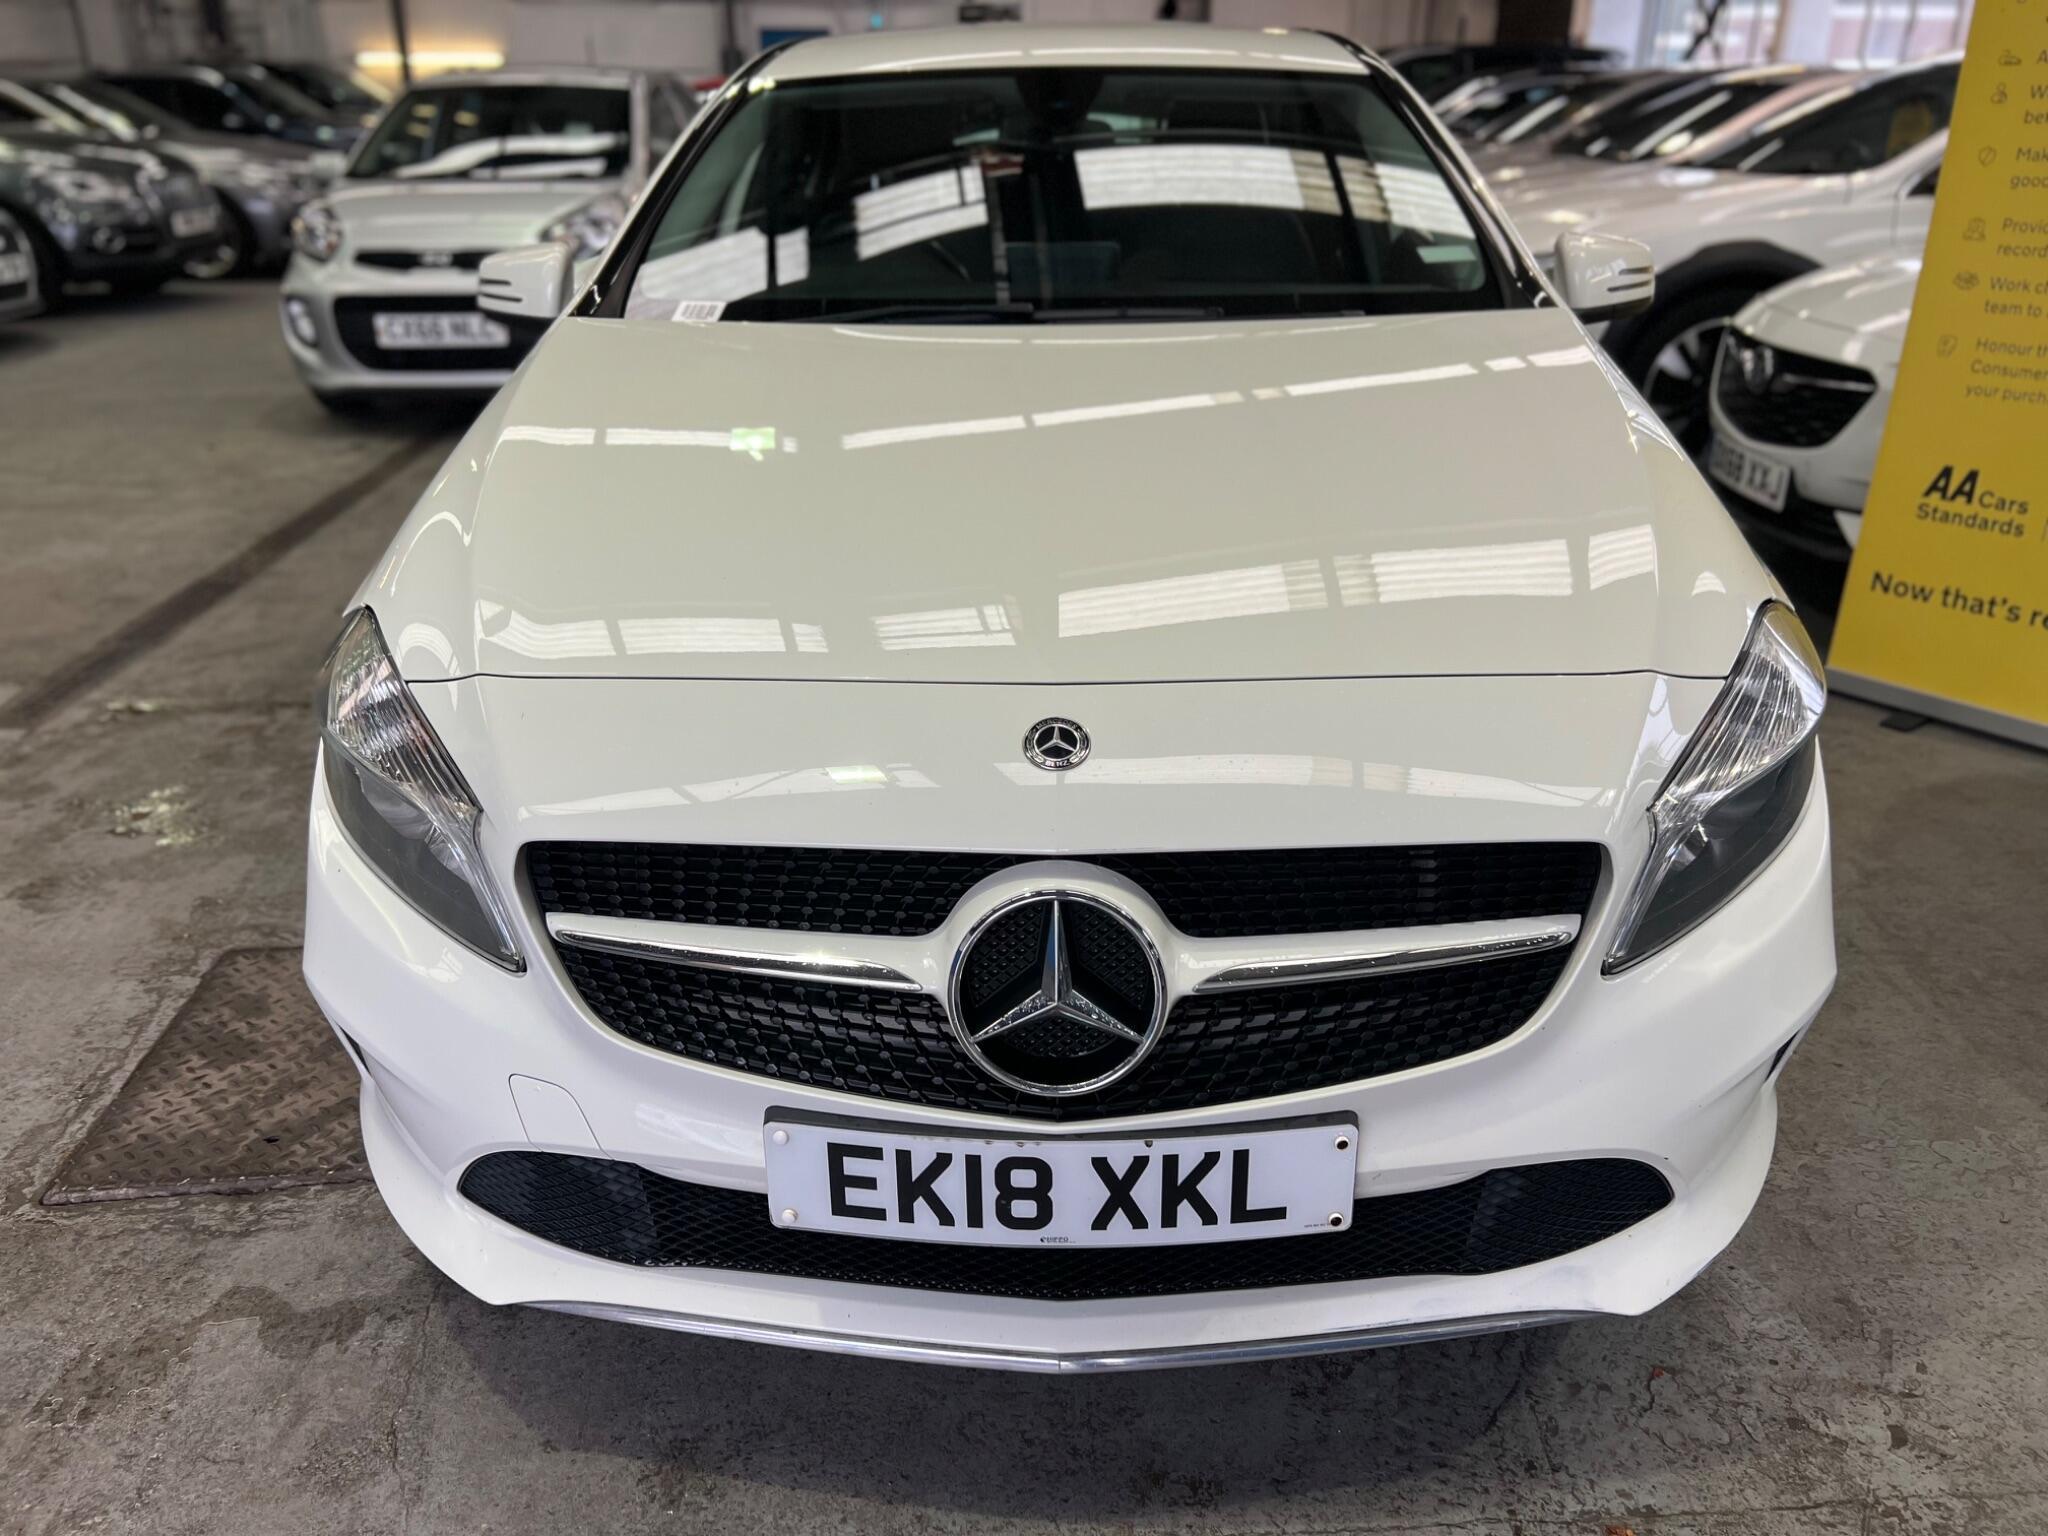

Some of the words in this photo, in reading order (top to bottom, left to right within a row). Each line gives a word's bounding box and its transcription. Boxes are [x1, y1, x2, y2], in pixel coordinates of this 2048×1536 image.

[2024, 109, 2048, 125] be
[1989, 276, 2031, 293] Work
[1984, 299, 2023, 316] team
[2027, 303, 2042, 319] to
[1976, 337, 2033, 357] Honour
[1965, 384, 2000, 399] your
[1922, 464, 1980, 506] AA
[1979, 490, 2029, 516] Cars
[1916, 502, 2025, 538] Standards
[1870, 570, 1934, 603] Now
[1941, 585, 2021, 624] that's
[826, 1141, 1054, 1230] EK18
[1090, 1148, 1288, 1231] XKL
